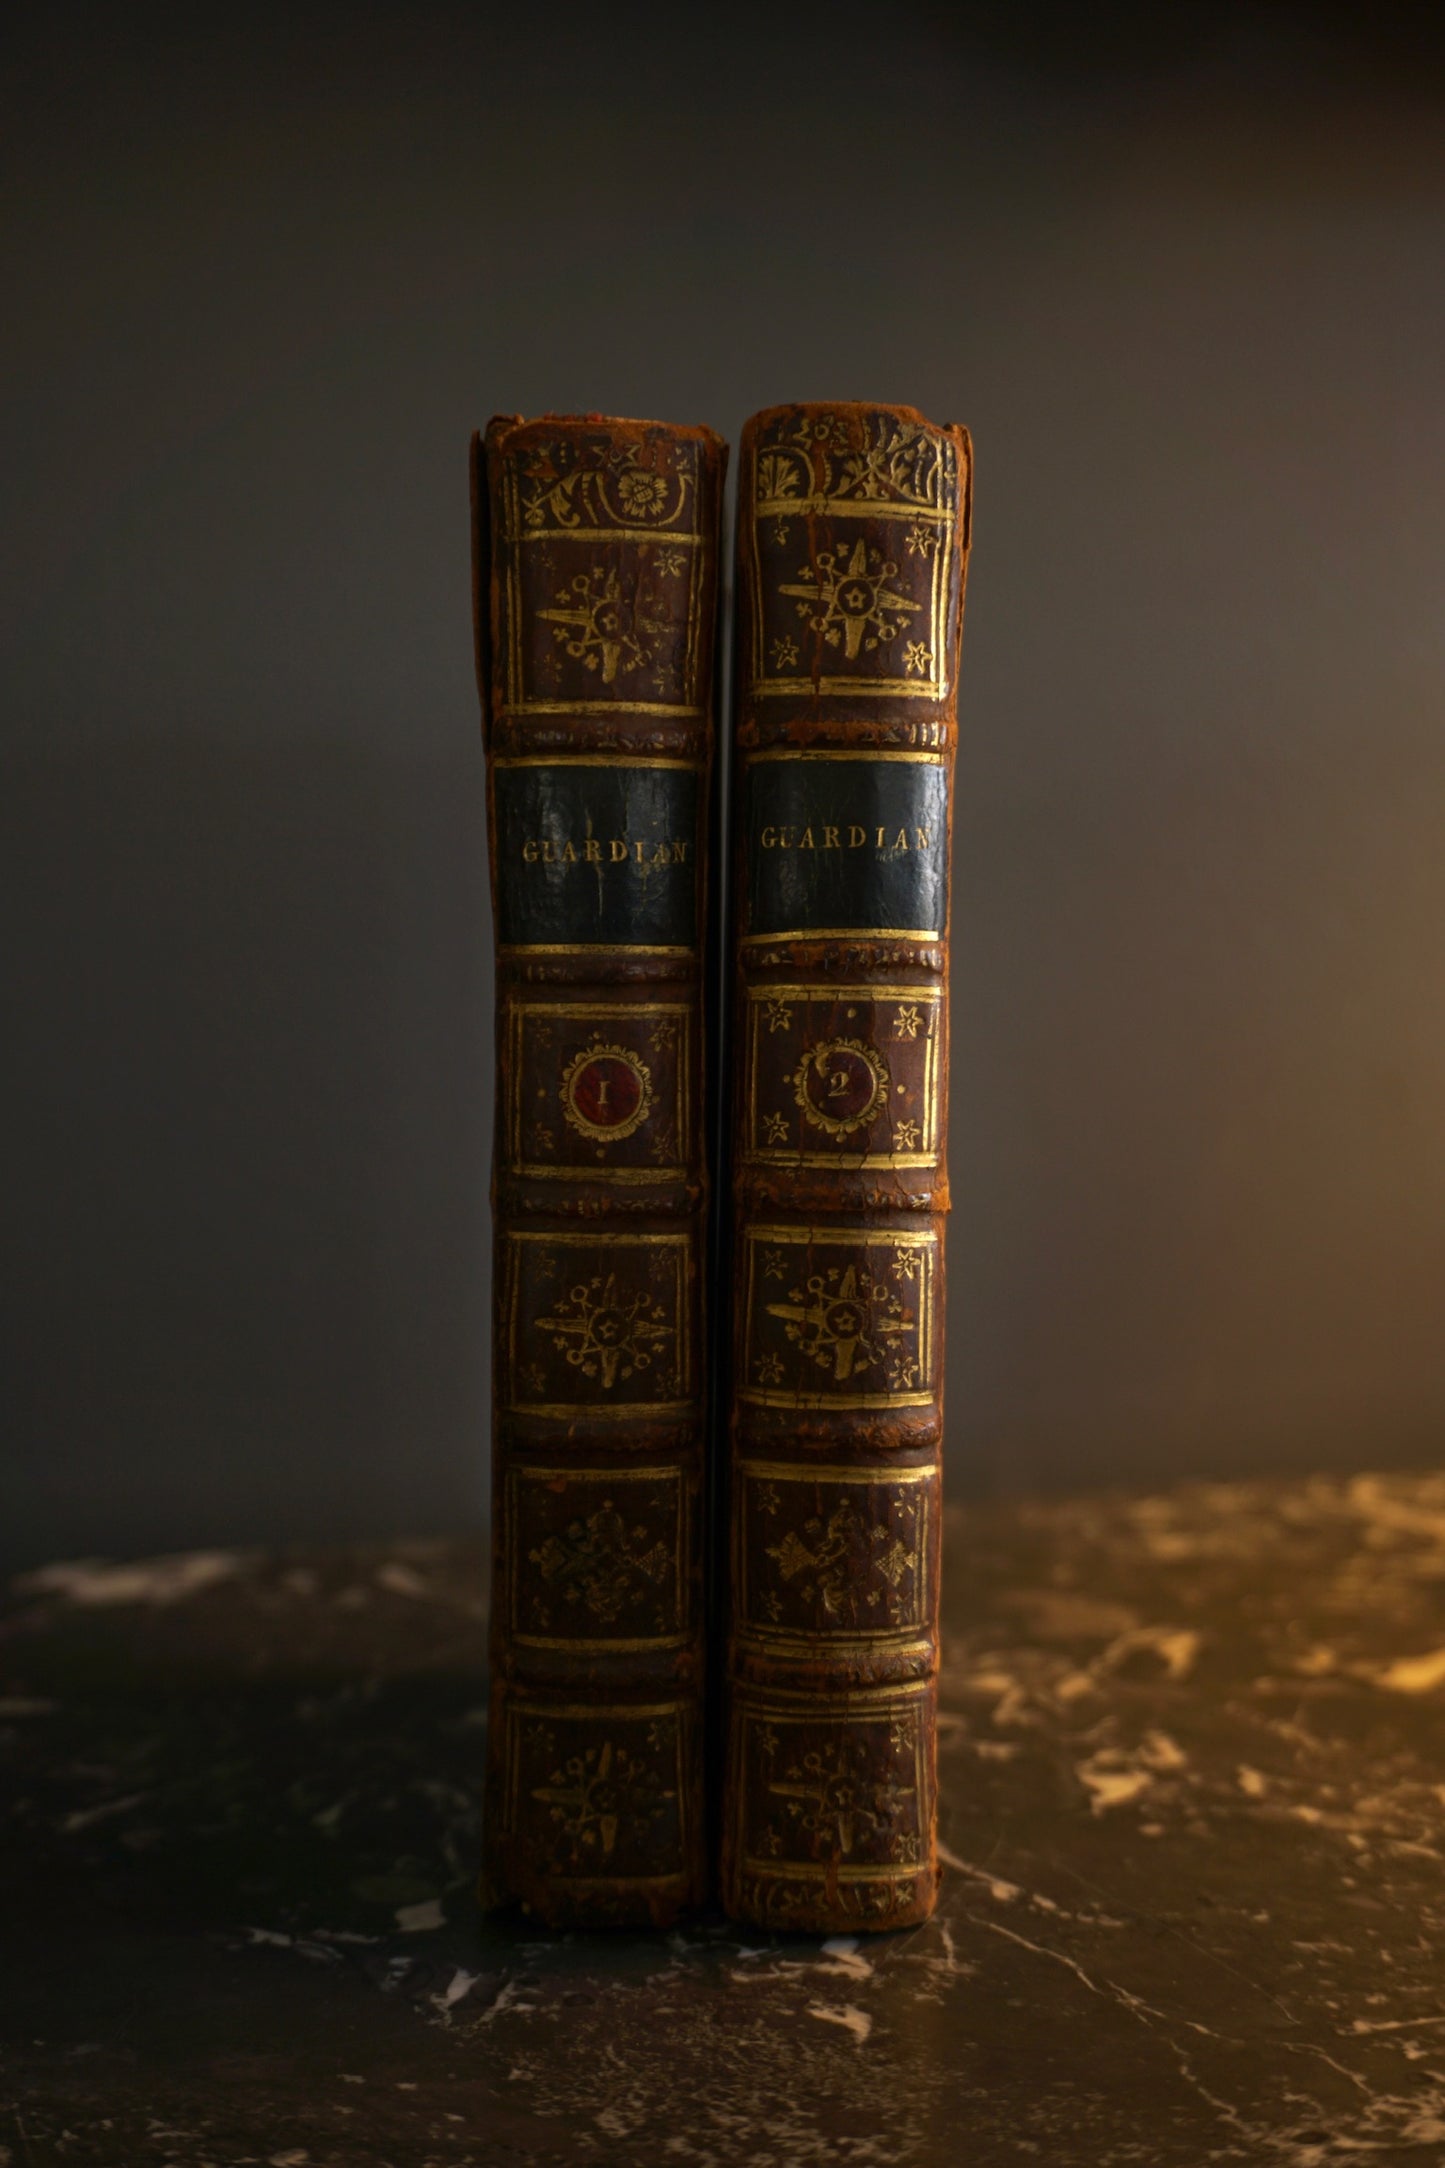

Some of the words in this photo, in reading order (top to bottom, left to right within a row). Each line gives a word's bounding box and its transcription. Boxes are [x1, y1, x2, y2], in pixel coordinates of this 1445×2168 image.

[761, 825, 931, 850] GUARDIAN
[522, 838, 688, 864] GUARDIAN
[827, 1071, 849, 1097] 2
